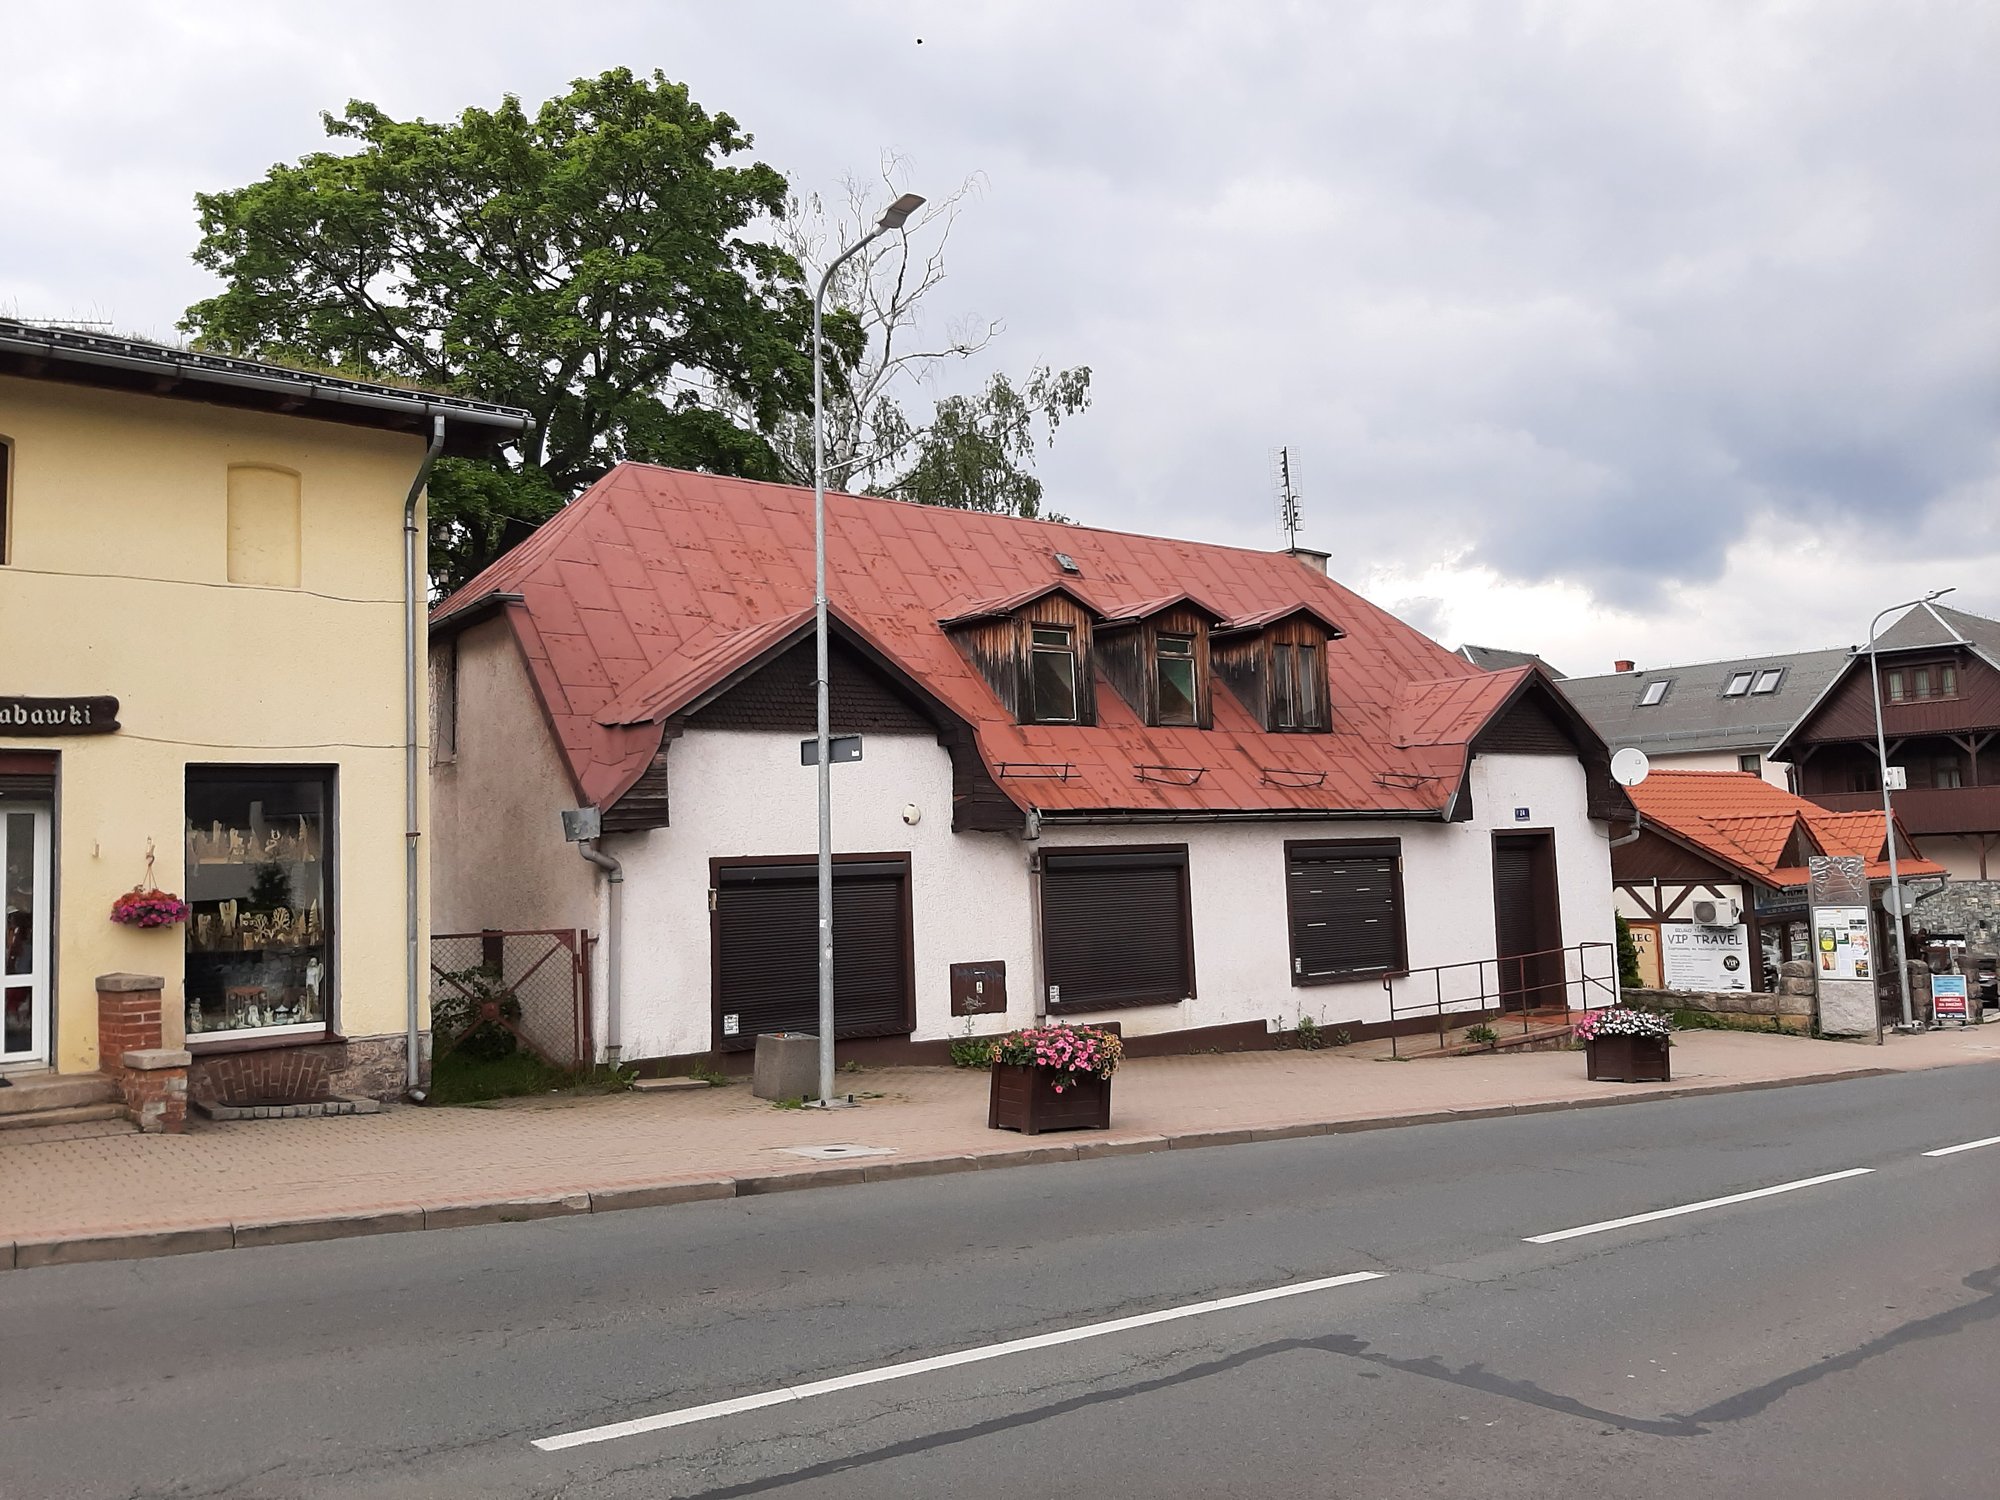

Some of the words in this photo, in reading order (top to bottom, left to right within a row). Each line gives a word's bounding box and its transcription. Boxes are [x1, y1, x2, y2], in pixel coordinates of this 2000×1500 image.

[0, 704, 91, 725] abawki
[1632, 933, 1652, 942] IEC
[1667, 934, 1688, 945] VIP
[1693, 934, 1743, 946] TRAVEL
